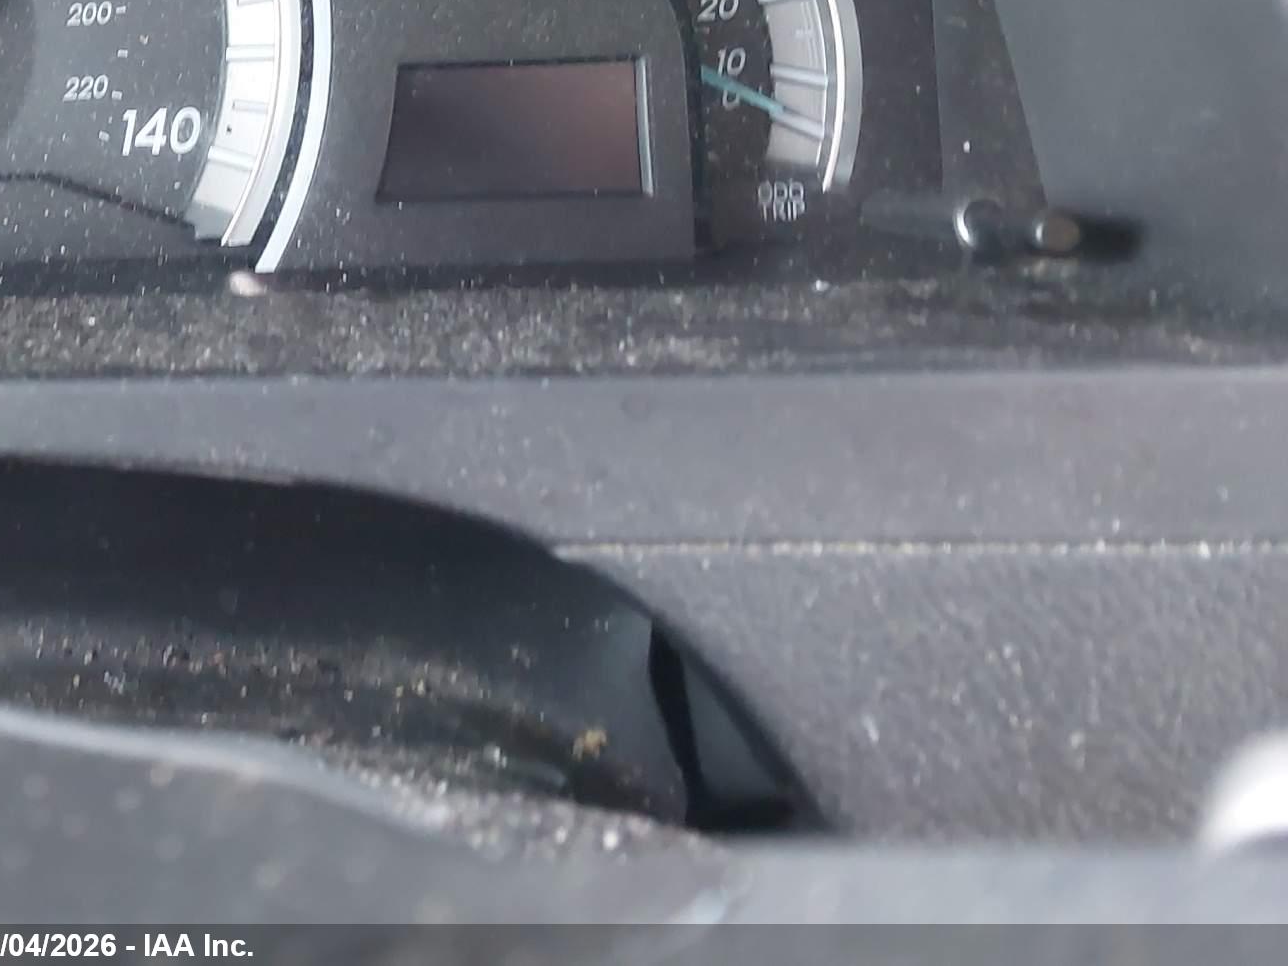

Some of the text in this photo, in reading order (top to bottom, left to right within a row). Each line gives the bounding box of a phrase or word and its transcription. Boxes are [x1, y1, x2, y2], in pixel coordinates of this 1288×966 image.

[66, 1, 112, 27] 200
[716, 47, 746, 76] 10
[63, 75, 109, 102] 220
[121, 106, 201, 156] 140
